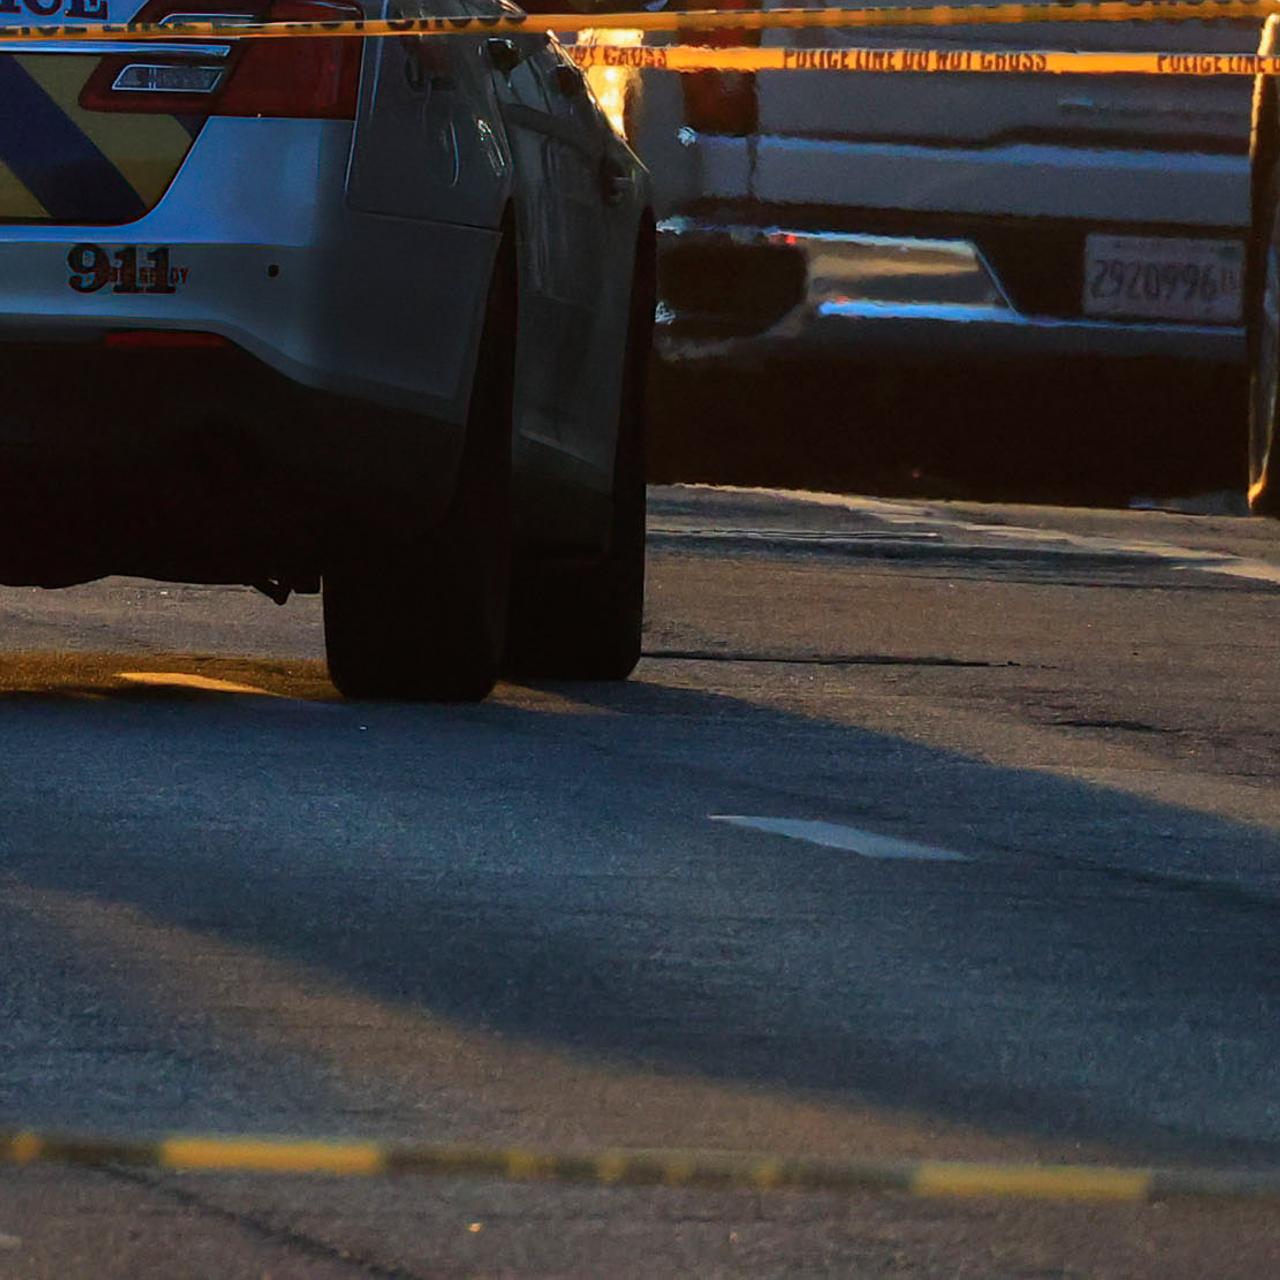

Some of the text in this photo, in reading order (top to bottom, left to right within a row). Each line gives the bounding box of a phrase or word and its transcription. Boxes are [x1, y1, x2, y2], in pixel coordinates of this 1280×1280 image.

[784, 50, 1047, 71] POLICE LINE DO NOT CROSS
[1157, 54, 1222, 72] POLICE
[67, 243, 177, 295] 911
